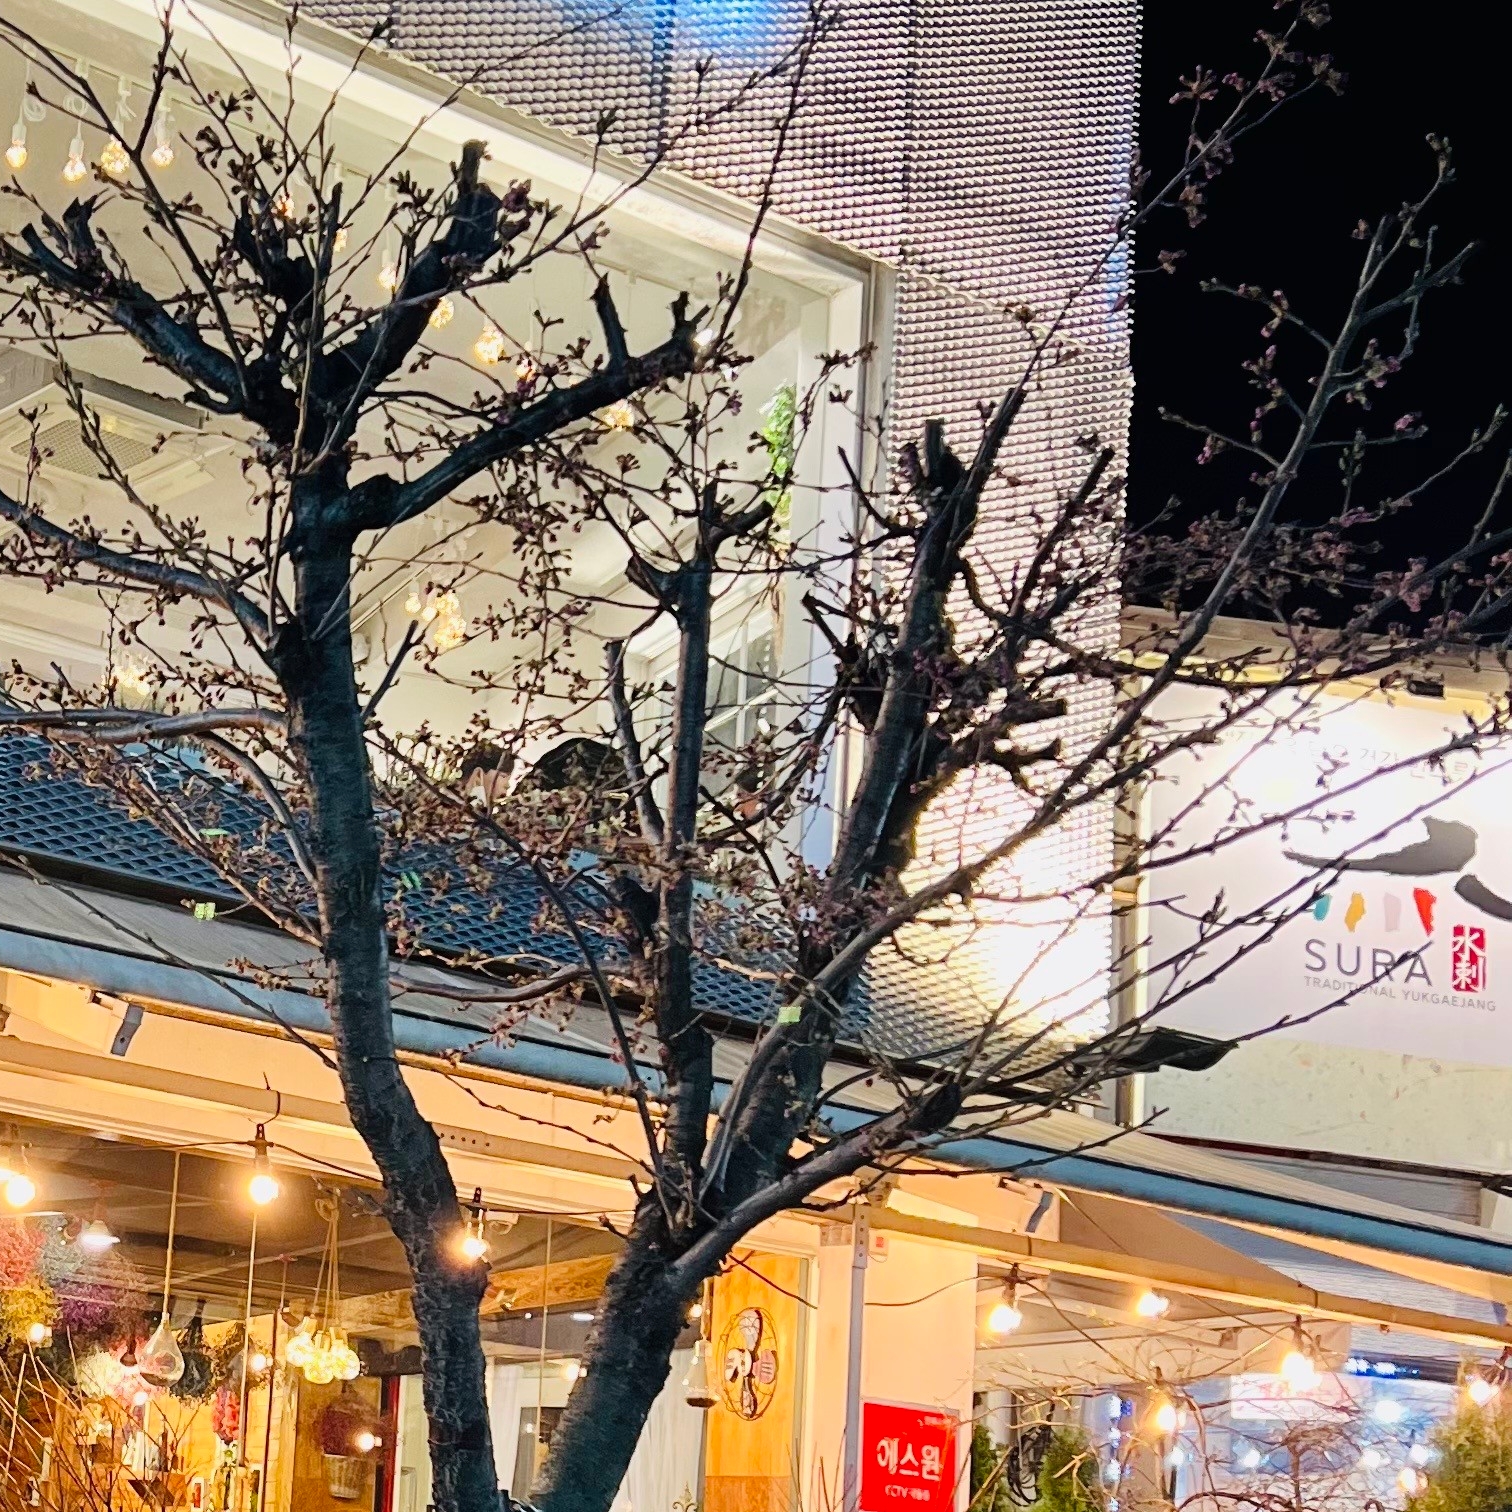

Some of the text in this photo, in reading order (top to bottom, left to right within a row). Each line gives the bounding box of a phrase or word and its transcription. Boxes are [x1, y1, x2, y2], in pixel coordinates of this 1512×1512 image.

[1305, 938, 1433, 987] SURA
[1401, 990, 1497, 1012] YUKGAEJANG
[876, 1436, 941, 1482] 에스원
